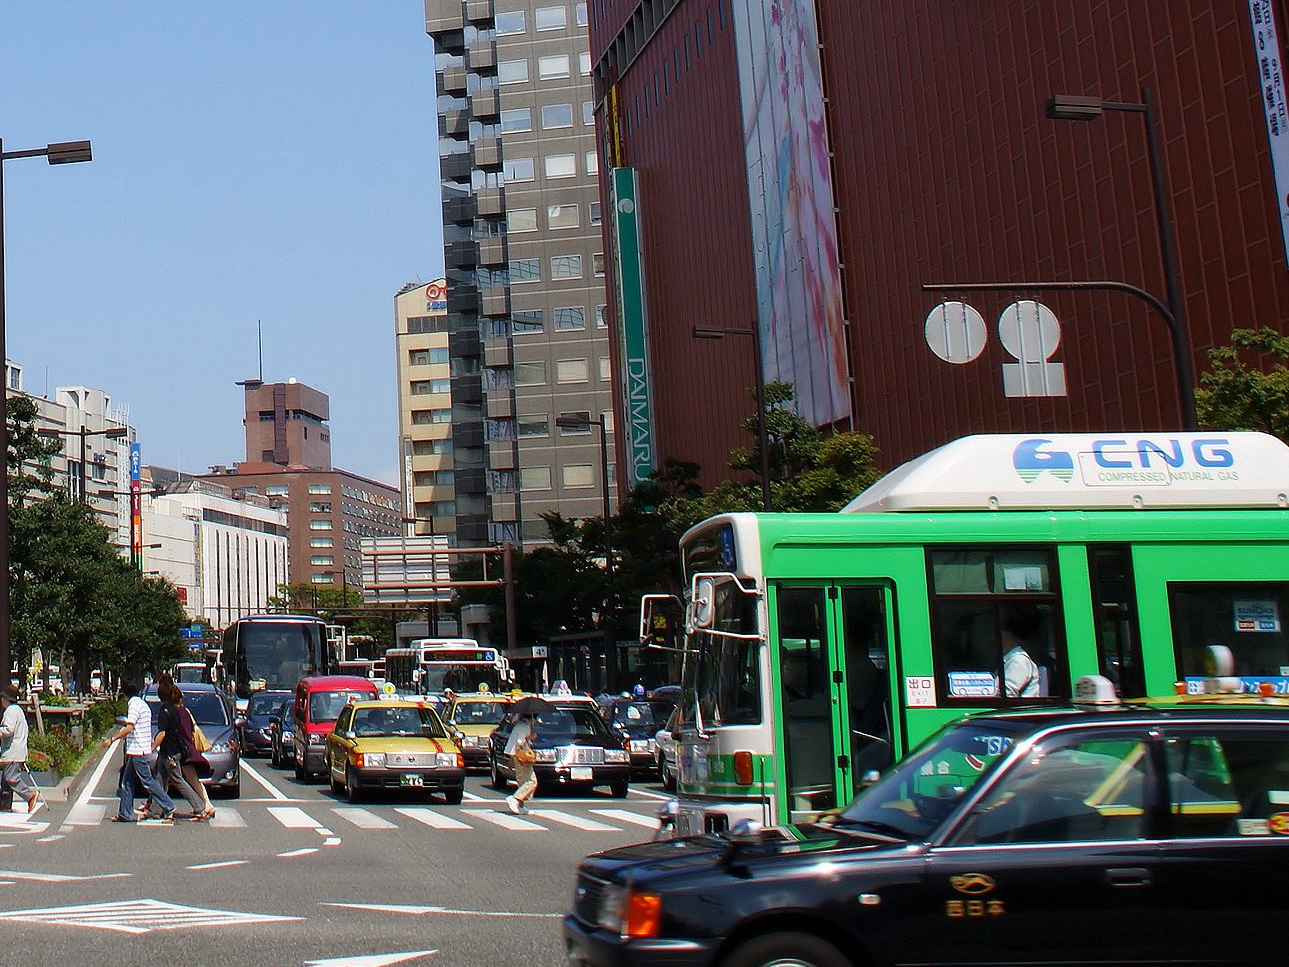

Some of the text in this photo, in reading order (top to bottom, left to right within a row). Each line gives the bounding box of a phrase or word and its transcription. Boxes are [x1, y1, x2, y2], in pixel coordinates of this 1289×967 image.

[628, 357, 654, 483] DAIMARU
[1092, 438, 1235, 468] CNG
[1098, 471, 1239, 482] COMPRESSED NATURAL GAS
[908, 678, 931, 689] 出口
[945, 900, 1005, 918] 西日本
